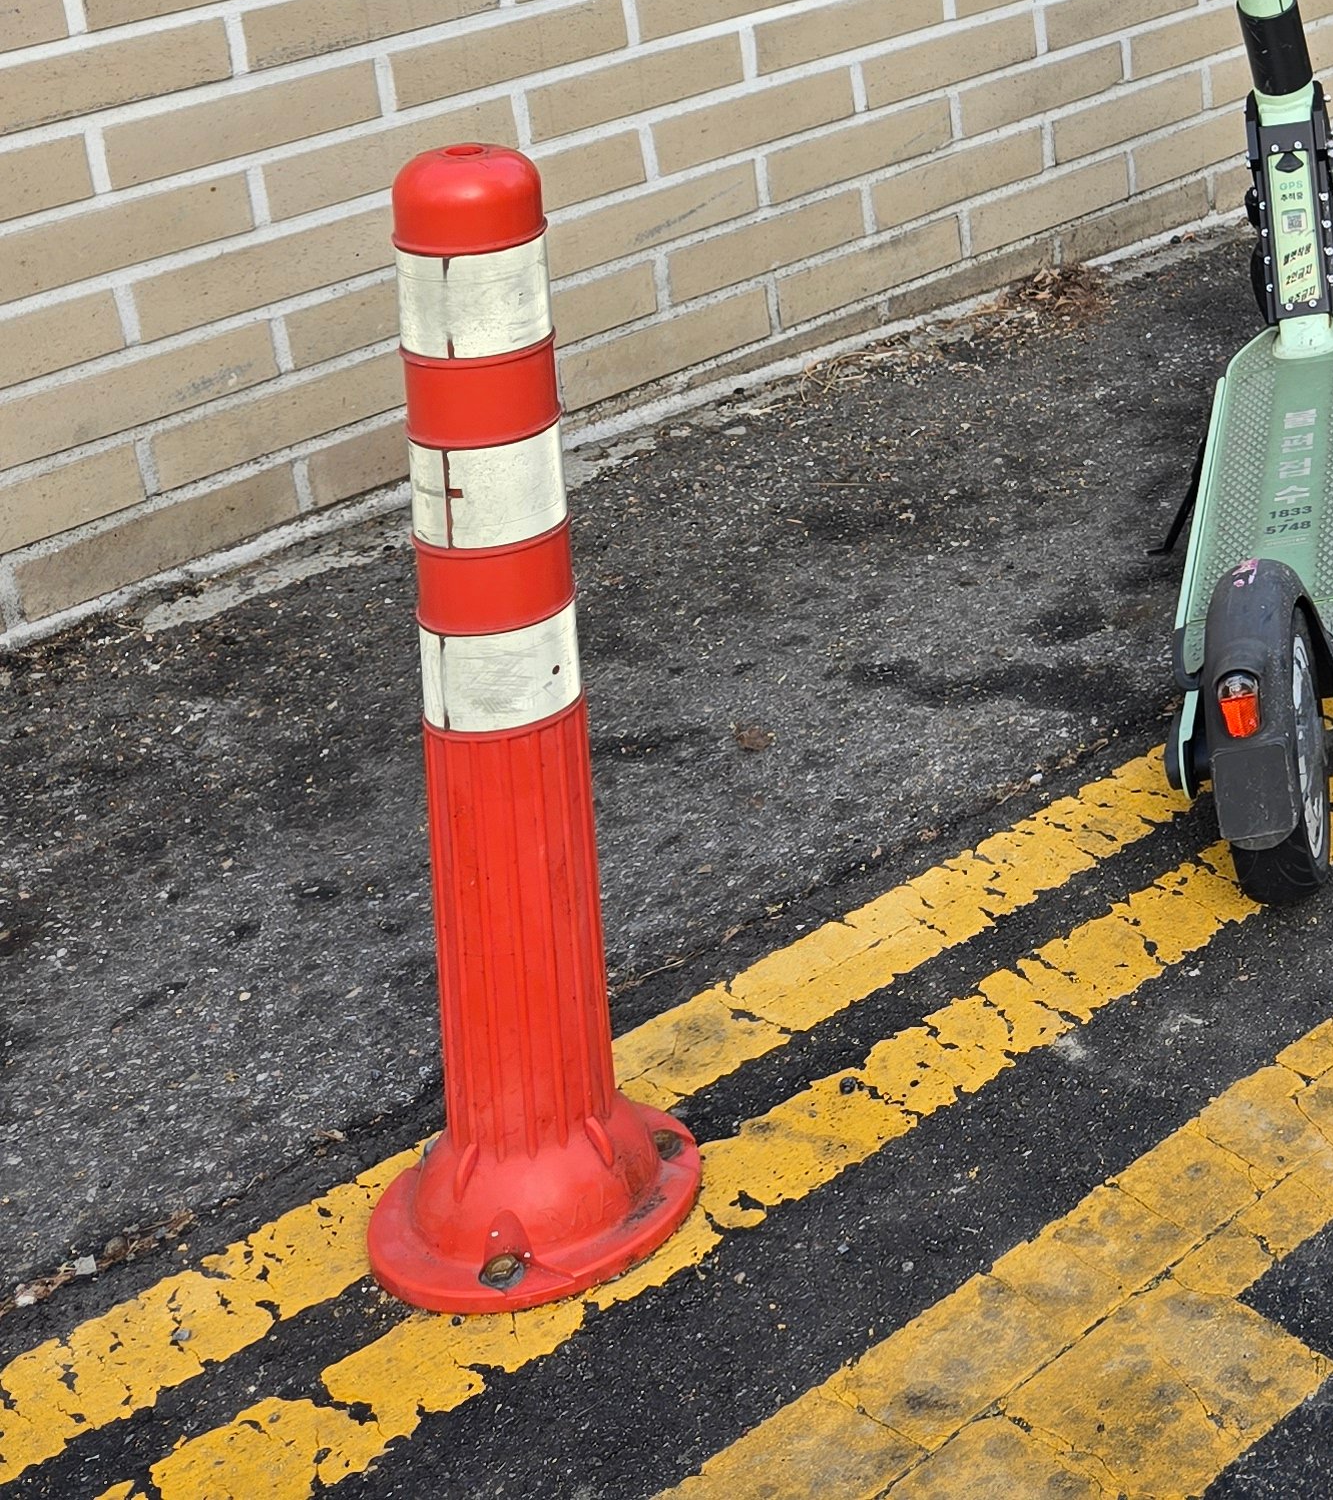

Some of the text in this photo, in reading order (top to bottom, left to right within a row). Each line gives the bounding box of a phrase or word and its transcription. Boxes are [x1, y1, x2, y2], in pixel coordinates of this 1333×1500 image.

[1279, 181, 1304, 192] GPS
[1269, 505, 1313, 519] 1833
[1264, 520, 1311, 535] 5748
